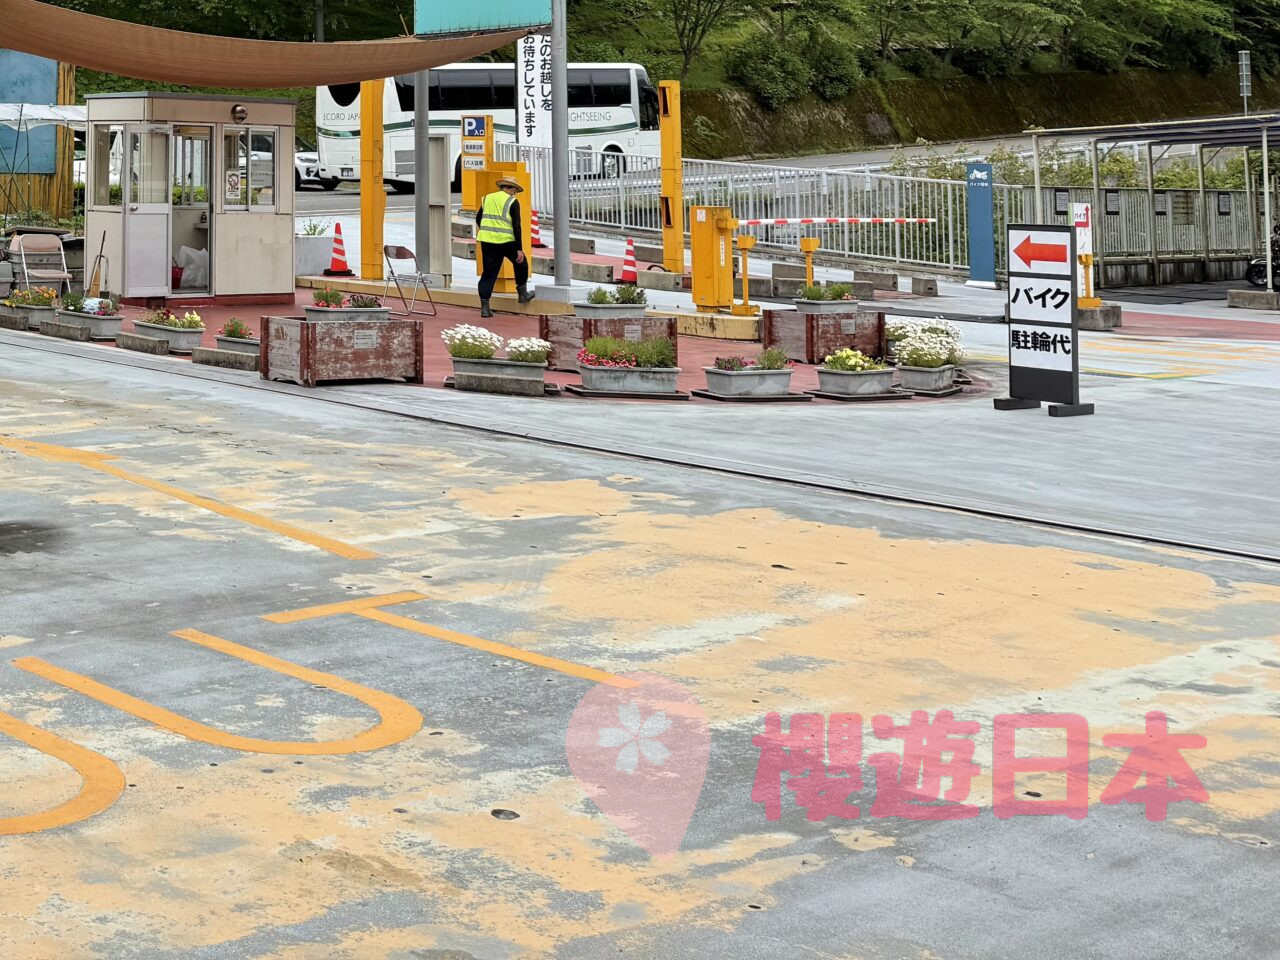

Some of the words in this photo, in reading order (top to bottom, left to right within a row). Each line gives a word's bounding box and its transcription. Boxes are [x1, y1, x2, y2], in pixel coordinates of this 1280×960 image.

[464, 118, 477, 136] P
[1011, 286, 1070, 310] バイク
[1011, 329, 1072, 355] 駐輪代
